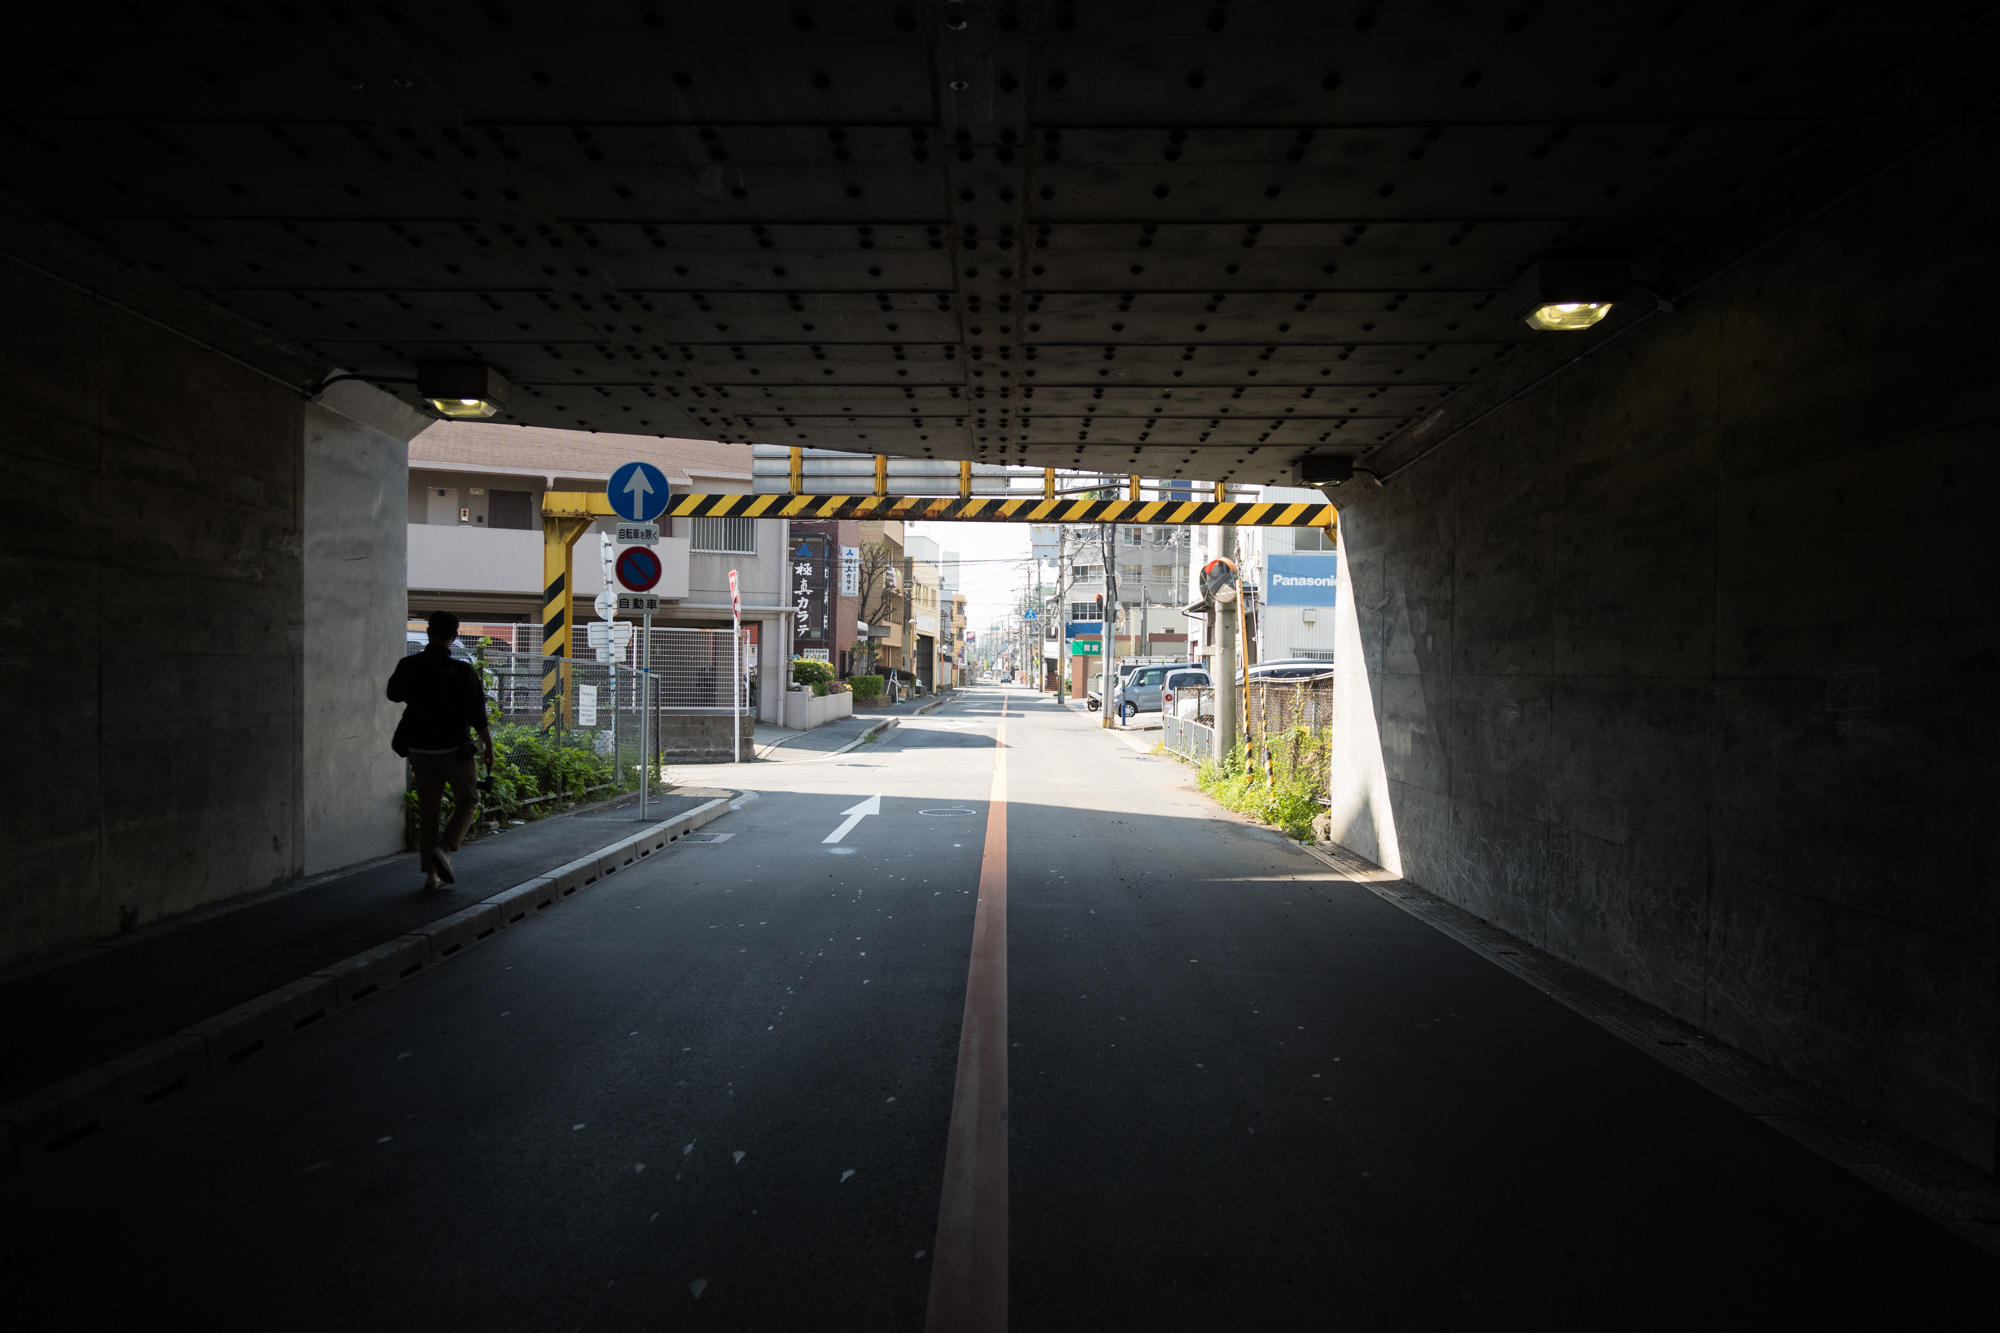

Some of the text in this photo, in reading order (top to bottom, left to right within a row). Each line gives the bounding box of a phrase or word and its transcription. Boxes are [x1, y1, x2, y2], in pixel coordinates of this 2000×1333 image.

[618, 528, 658, 540] 自転車を除く
[619, 597, 658, 610] 自動車
[794, 563, 813, 637] 極真カラテ
